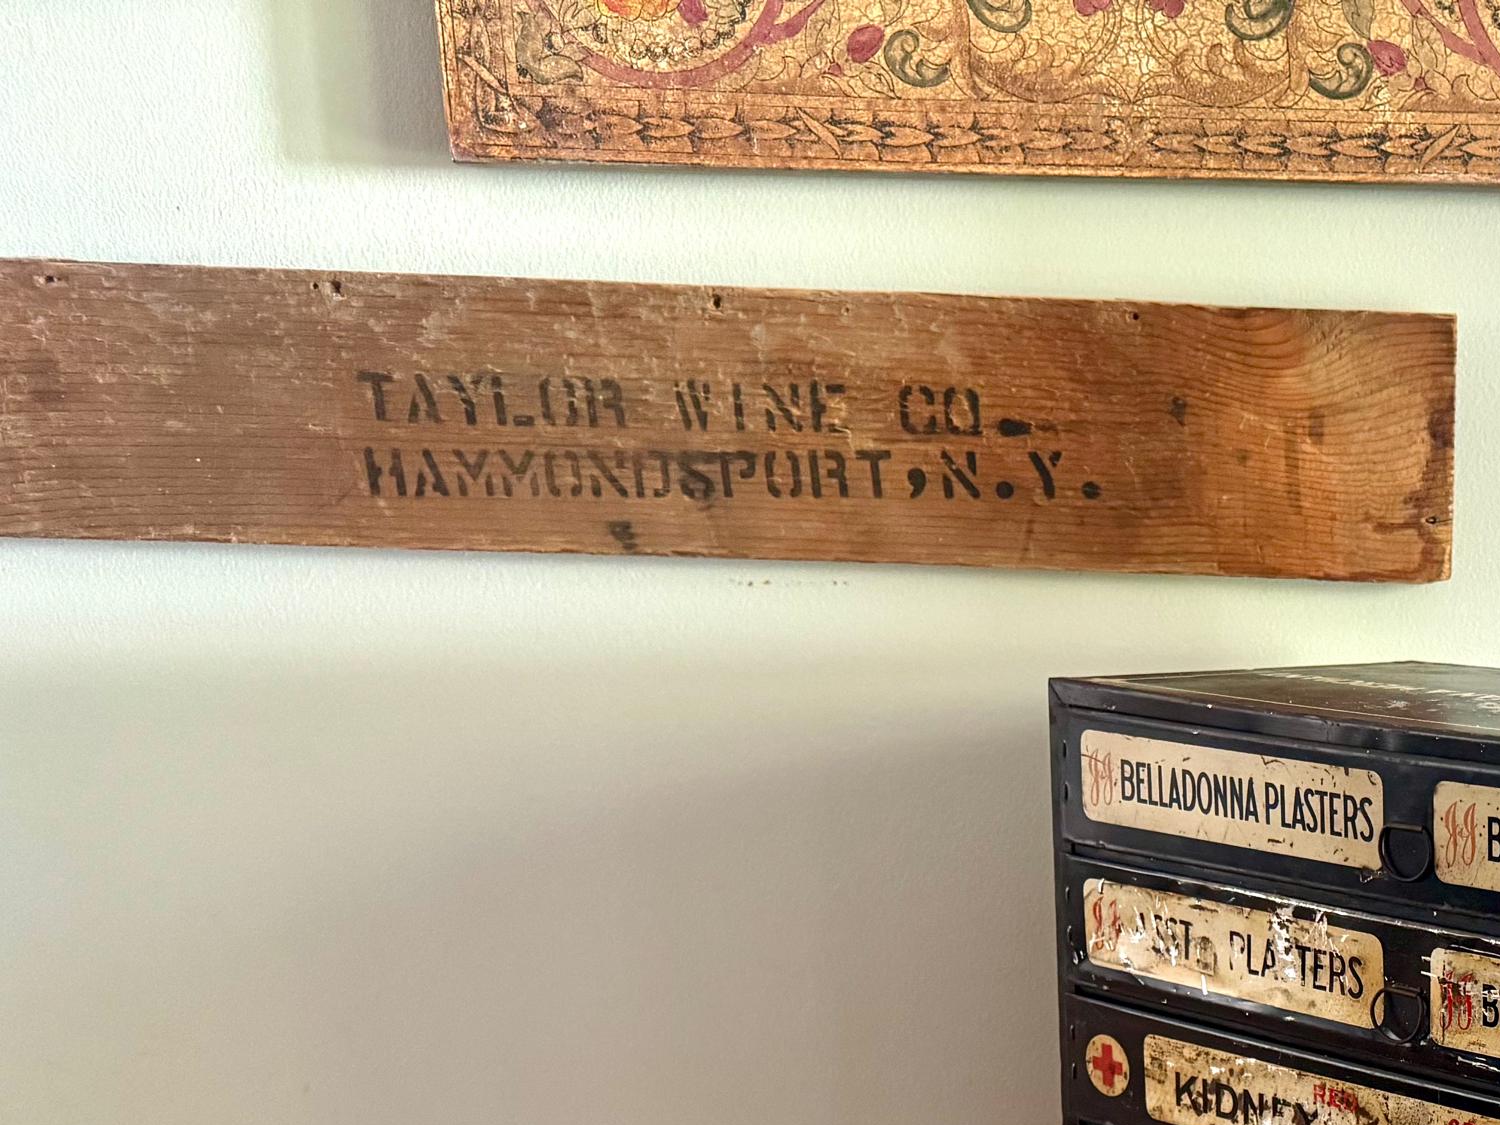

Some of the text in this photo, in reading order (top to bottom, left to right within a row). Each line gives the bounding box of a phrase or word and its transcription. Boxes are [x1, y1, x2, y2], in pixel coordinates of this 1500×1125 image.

[357, 371, 626, 428] TAYLOR
[673, 378, 846, 432] WINE
[1120, 758, 1260, 824] BELLADONNA
[1264, 781, 1375, 843] PLASTERS
[1229, 930, 1365, 1000] PLATERS
[1313, 1083, 1359, 1113] RED
